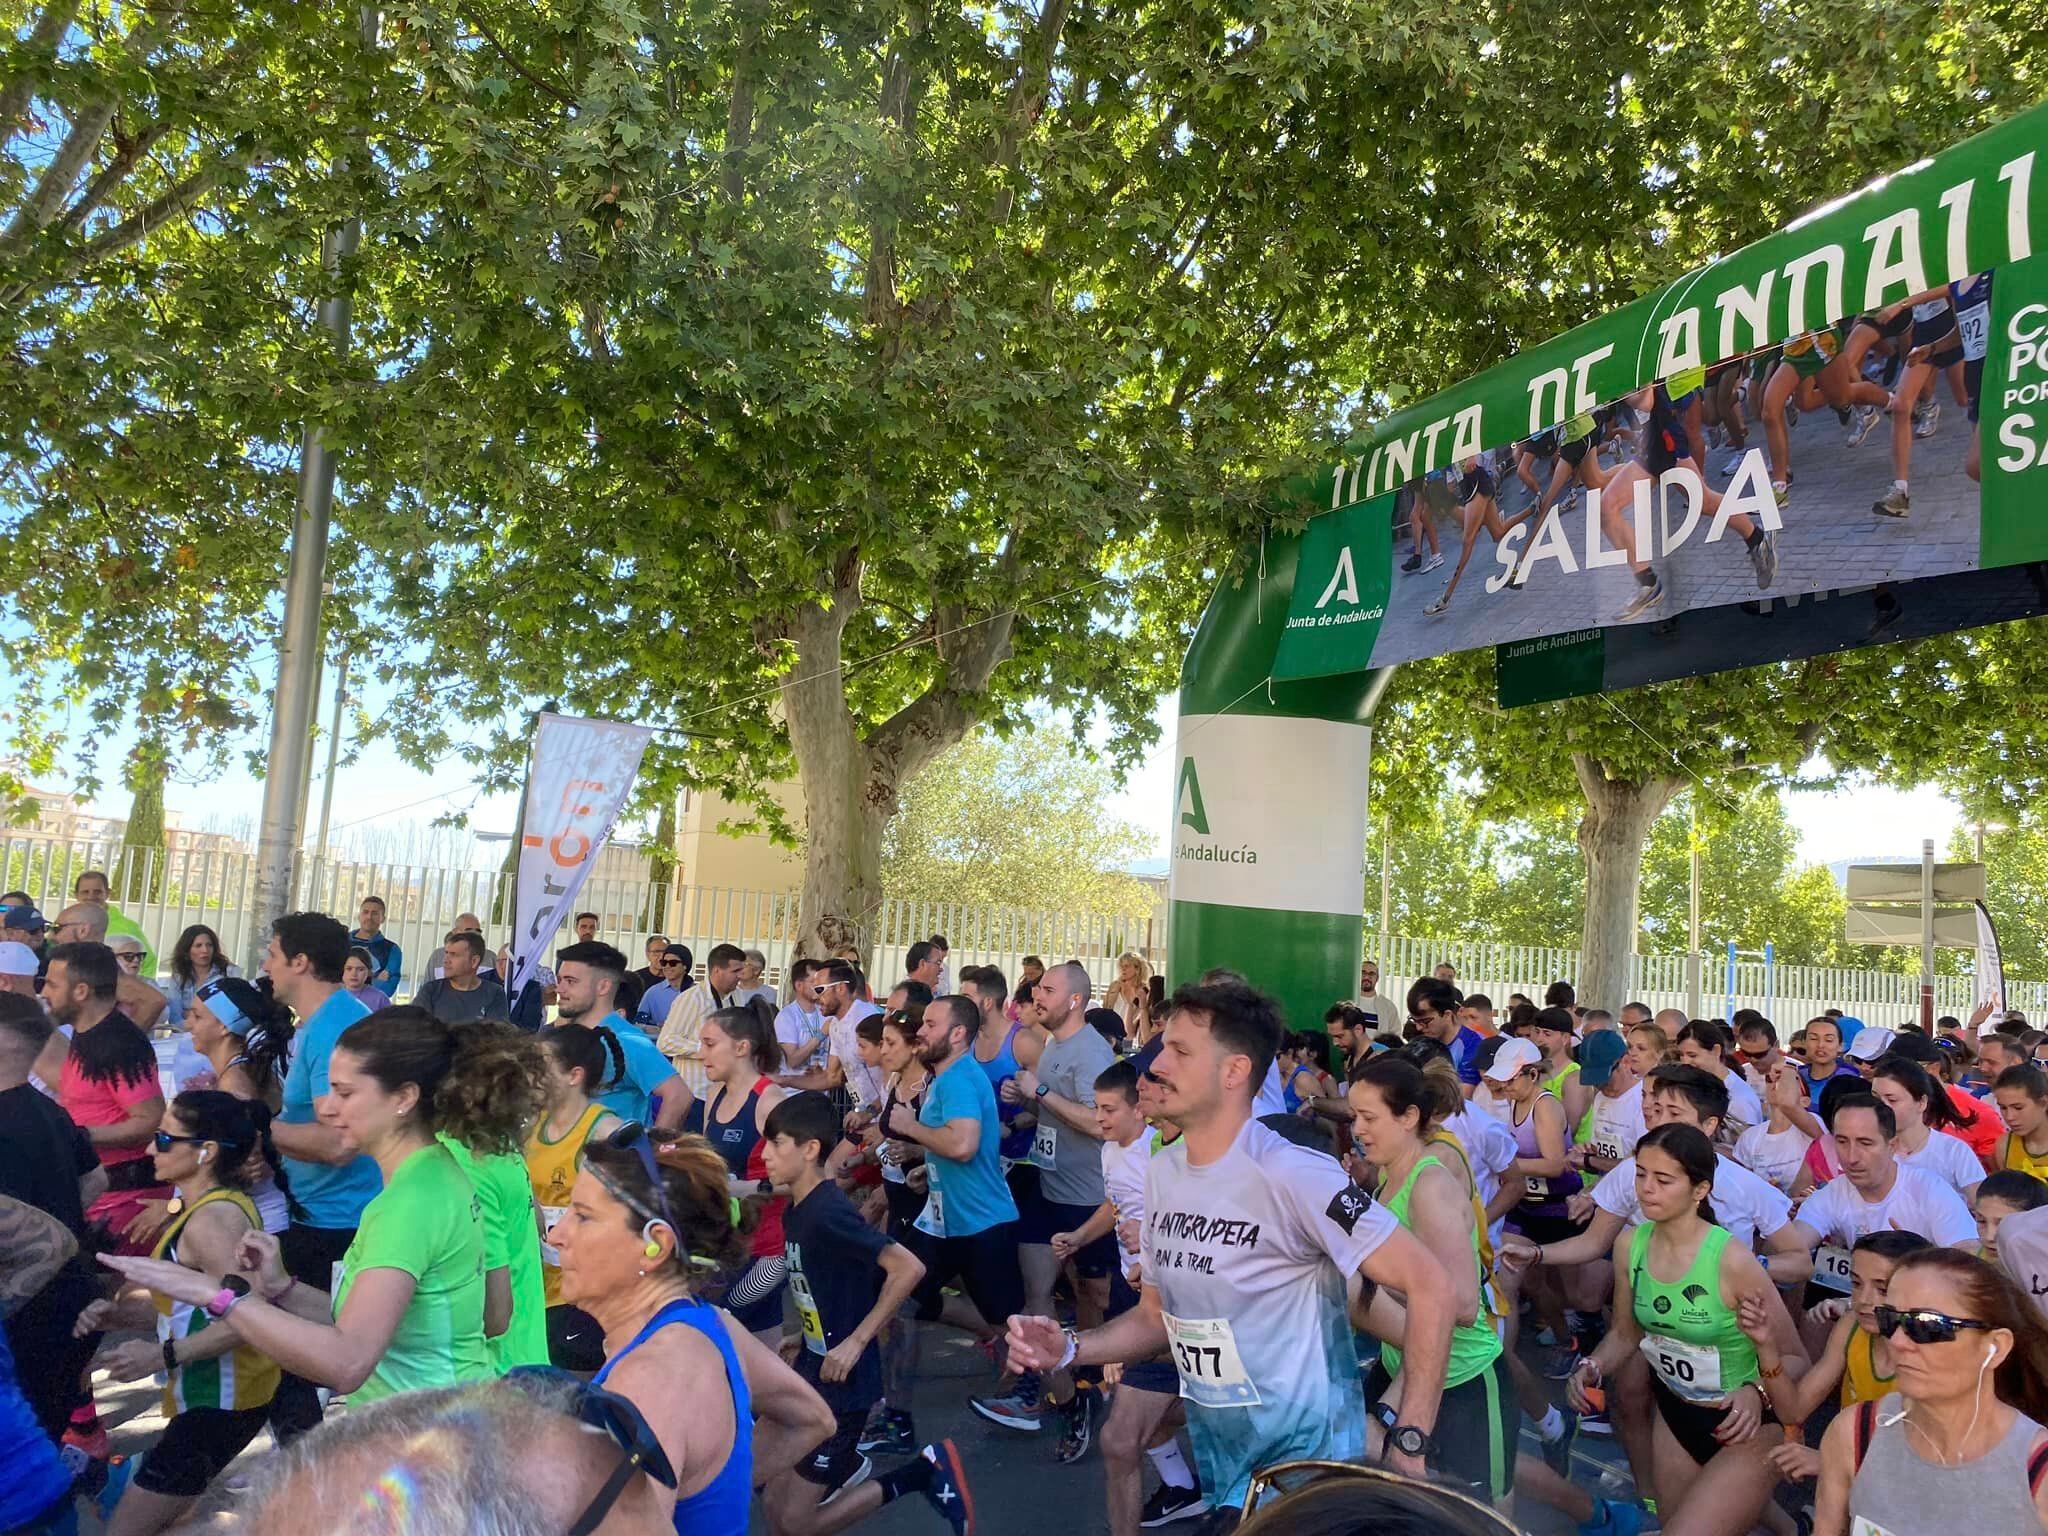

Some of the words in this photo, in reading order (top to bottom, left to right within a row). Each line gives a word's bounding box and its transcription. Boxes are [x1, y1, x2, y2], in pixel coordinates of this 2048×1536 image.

[1485, 447, 1783, 594] SALIDA
[1286, 616, 1316, 629] Junta
[1318, 613, 1332, 626] de
[1332, 604, 1384, 625] Andalucía
[1506, 643, 1535, 659] Junta
[1536, 639, 1549, 652] de
[1180, 843, 1258, 864] Andalucía
[1158, 1212, 1260, 1250] ANTIGRUPETA
[1188, 1252, 1216, 1275] TRAIL
[1176, 1341, 1222, 1378] 377
[1659, 1353, 1695, 1383] 50
